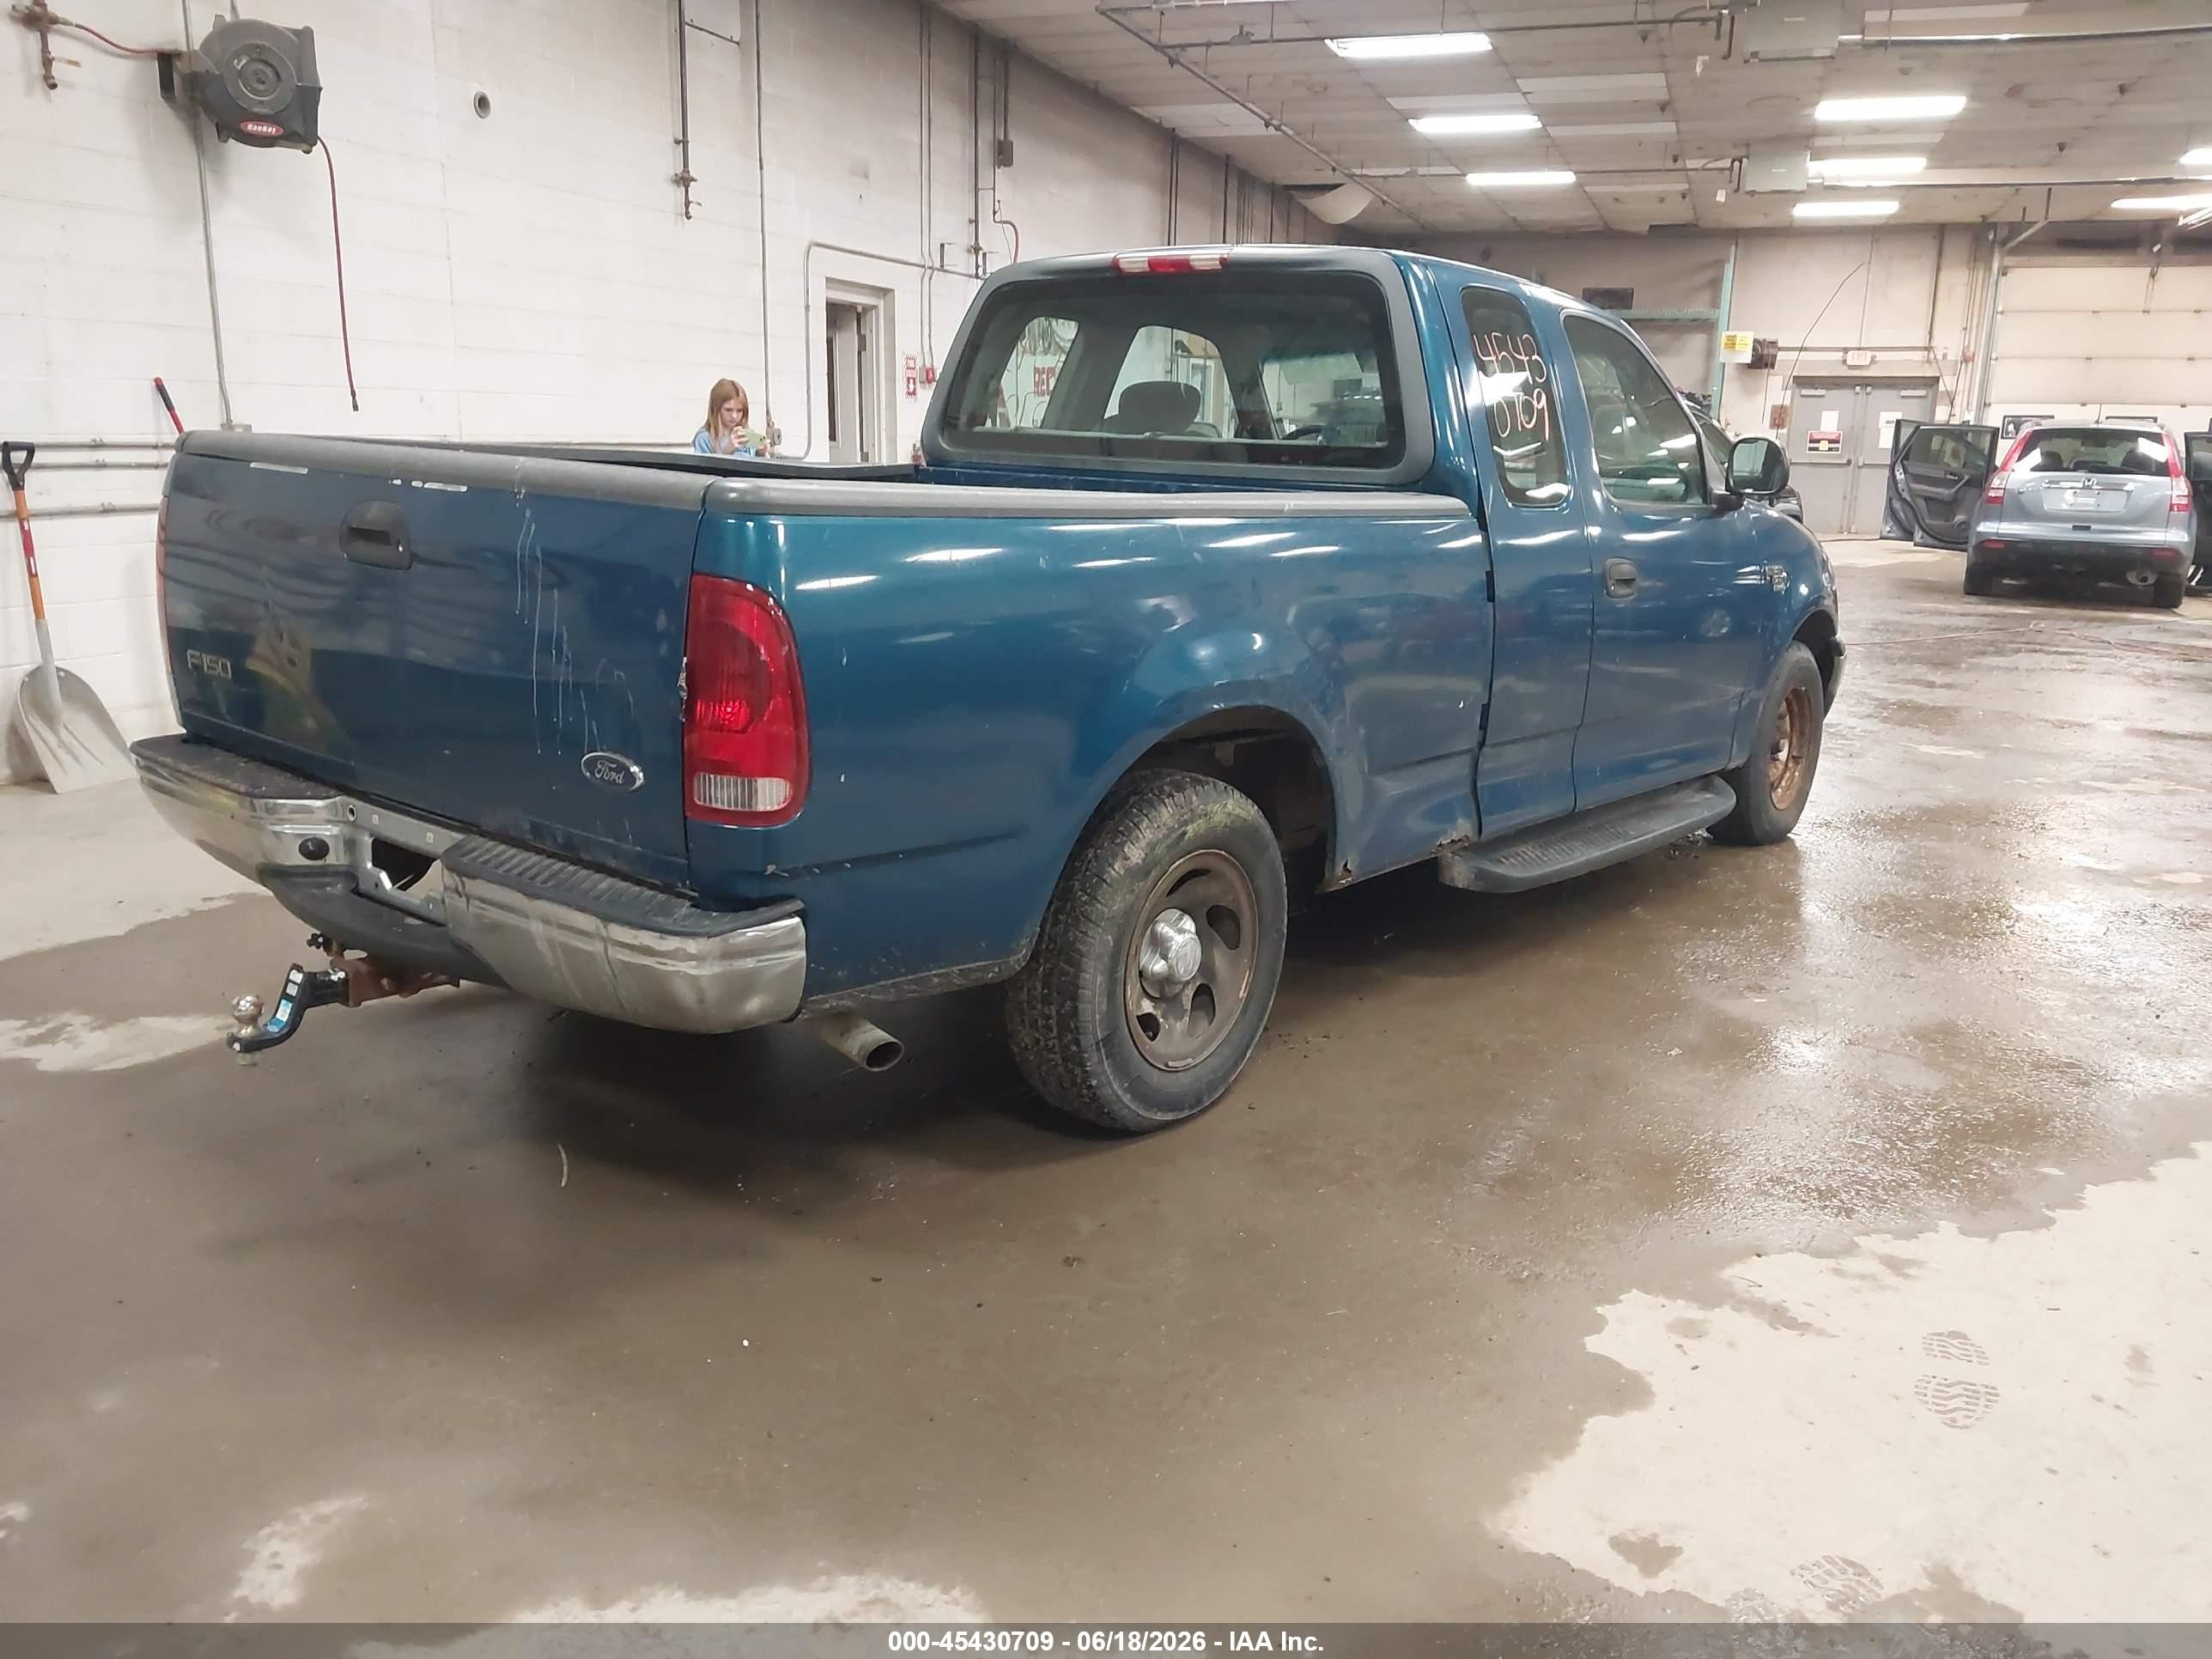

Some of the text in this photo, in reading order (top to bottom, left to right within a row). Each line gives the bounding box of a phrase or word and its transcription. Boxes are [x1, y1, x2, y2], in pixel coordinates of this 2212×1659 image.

[1473, 332, 1547, 385] 4543
[1492, 387, 1550, 442] 0709
[594, 760, 625, 784] Ford
